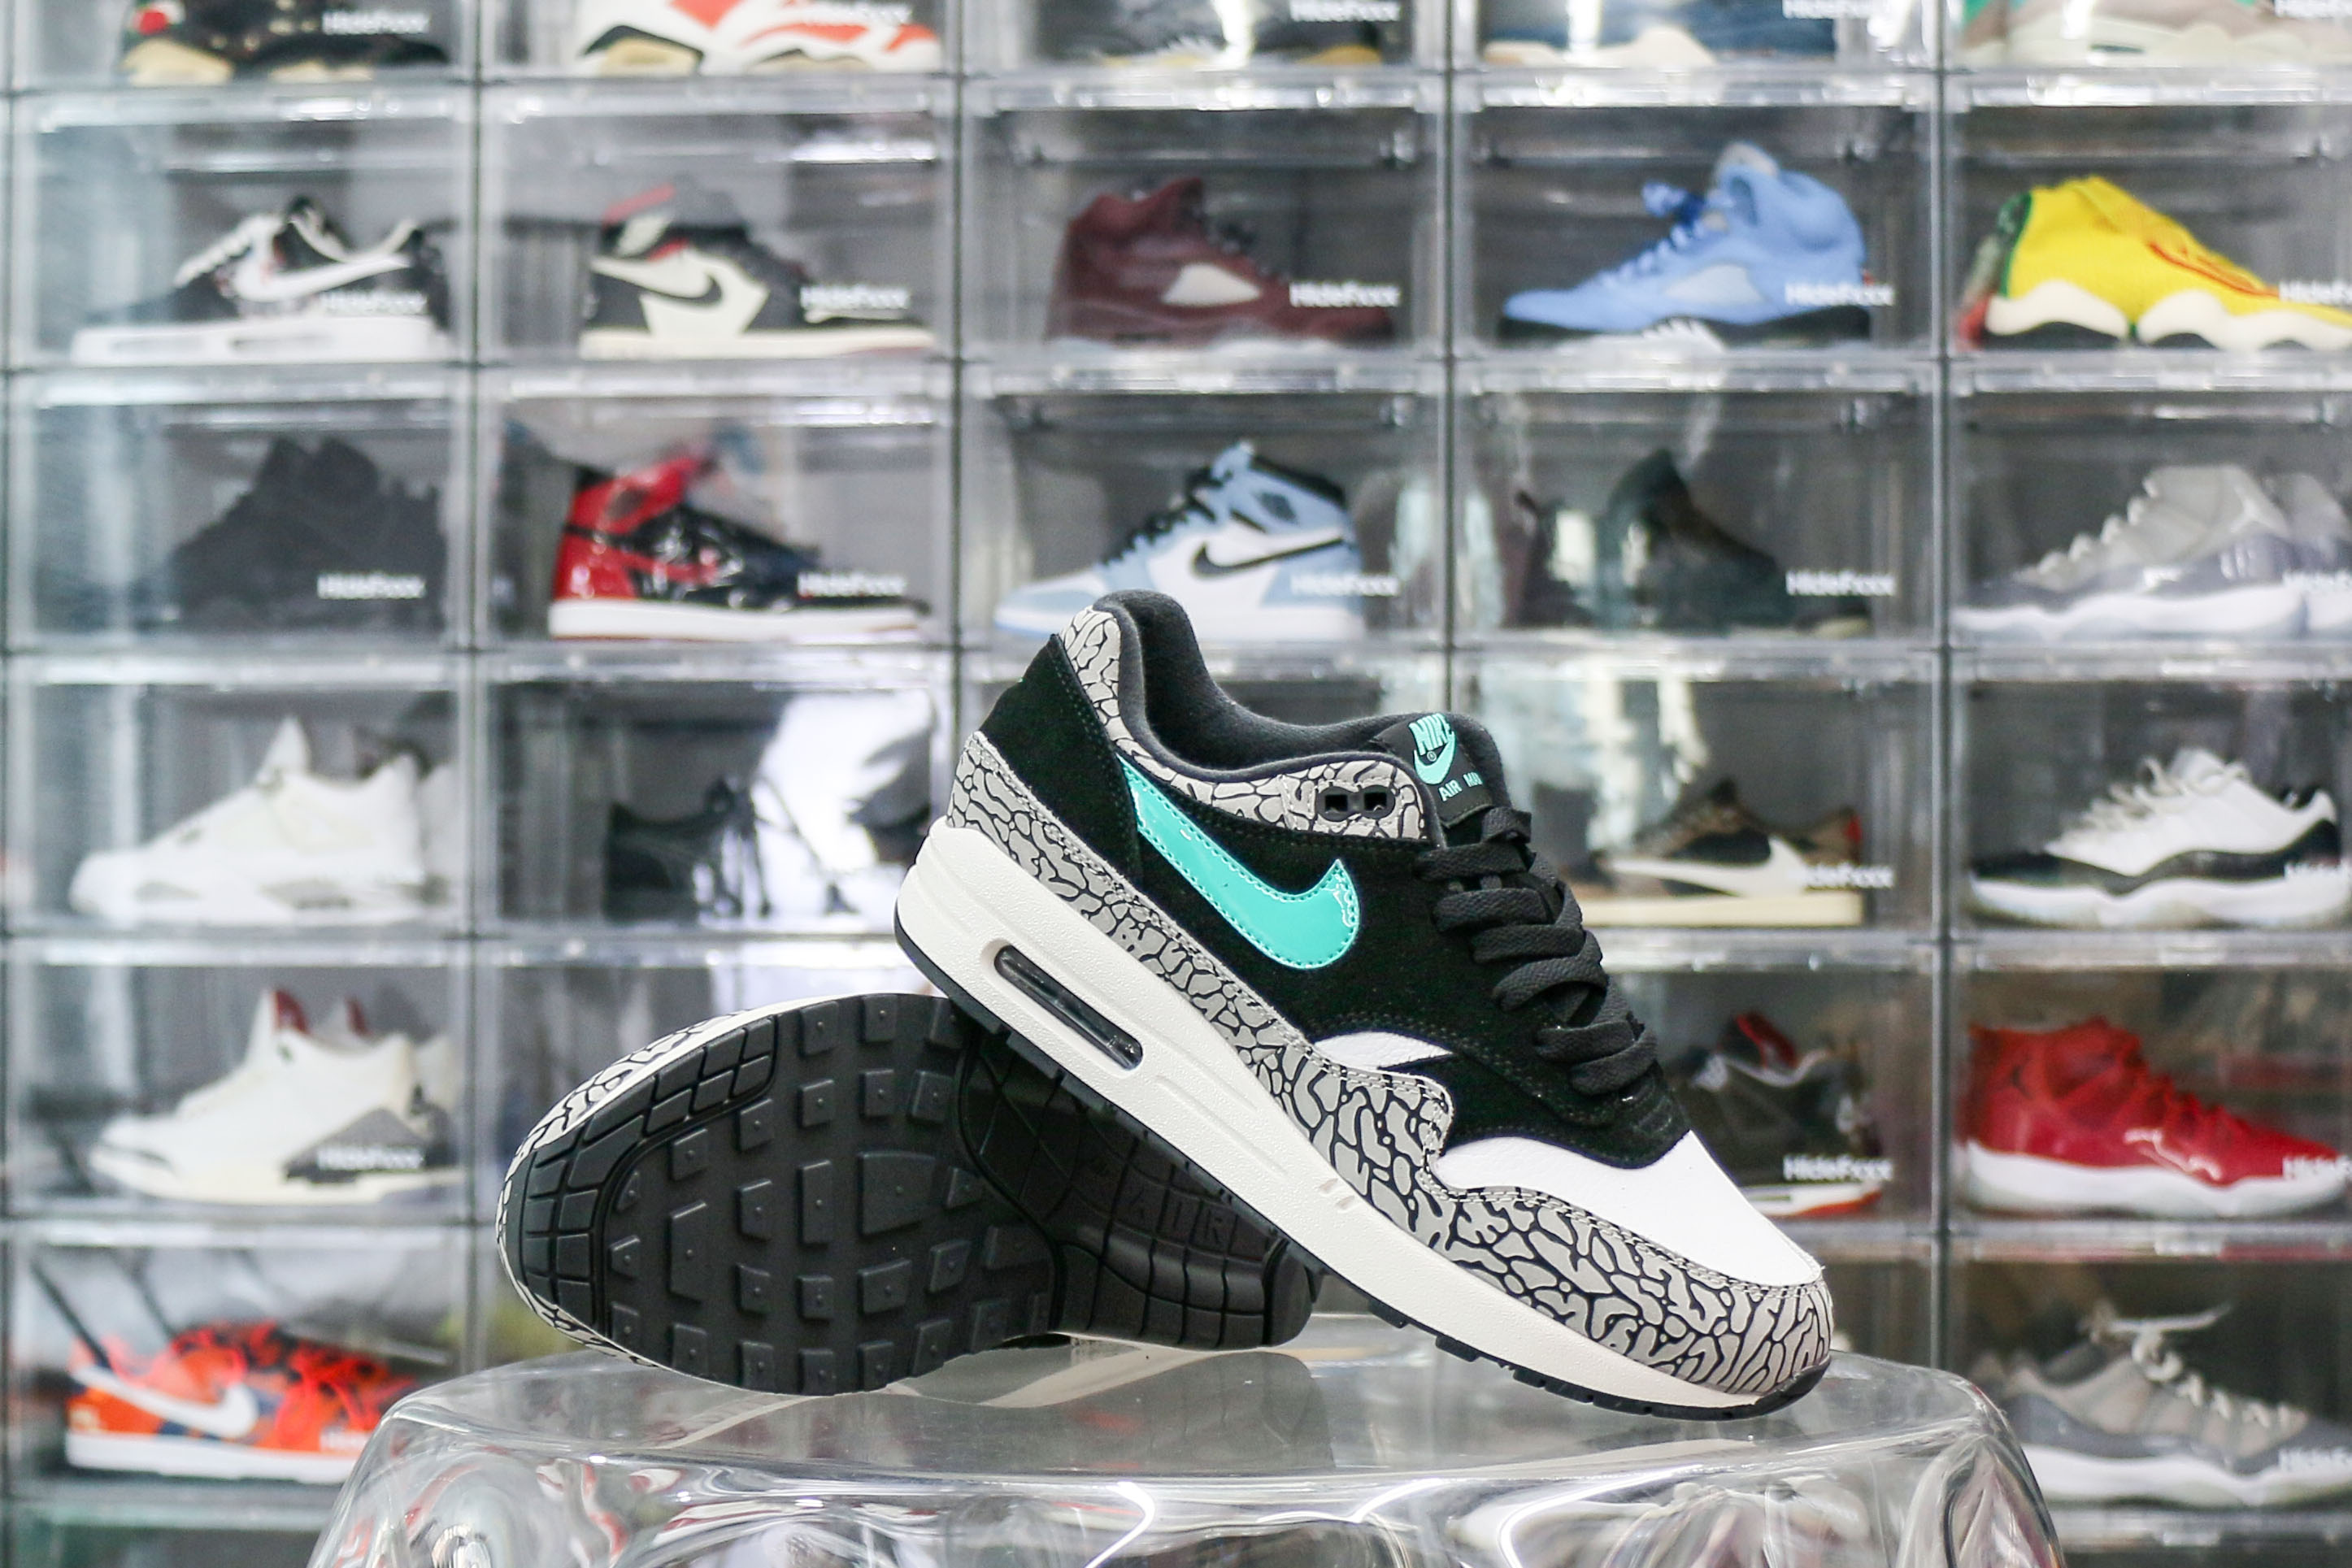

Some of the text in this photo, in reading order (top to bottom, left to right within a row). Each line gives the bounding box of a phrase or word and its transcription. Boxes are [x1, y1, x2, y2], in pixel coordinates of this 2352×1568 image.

[1409, 713, 1452, 756] NIKE
[1438, 771, 1484, 801] AIR MA
